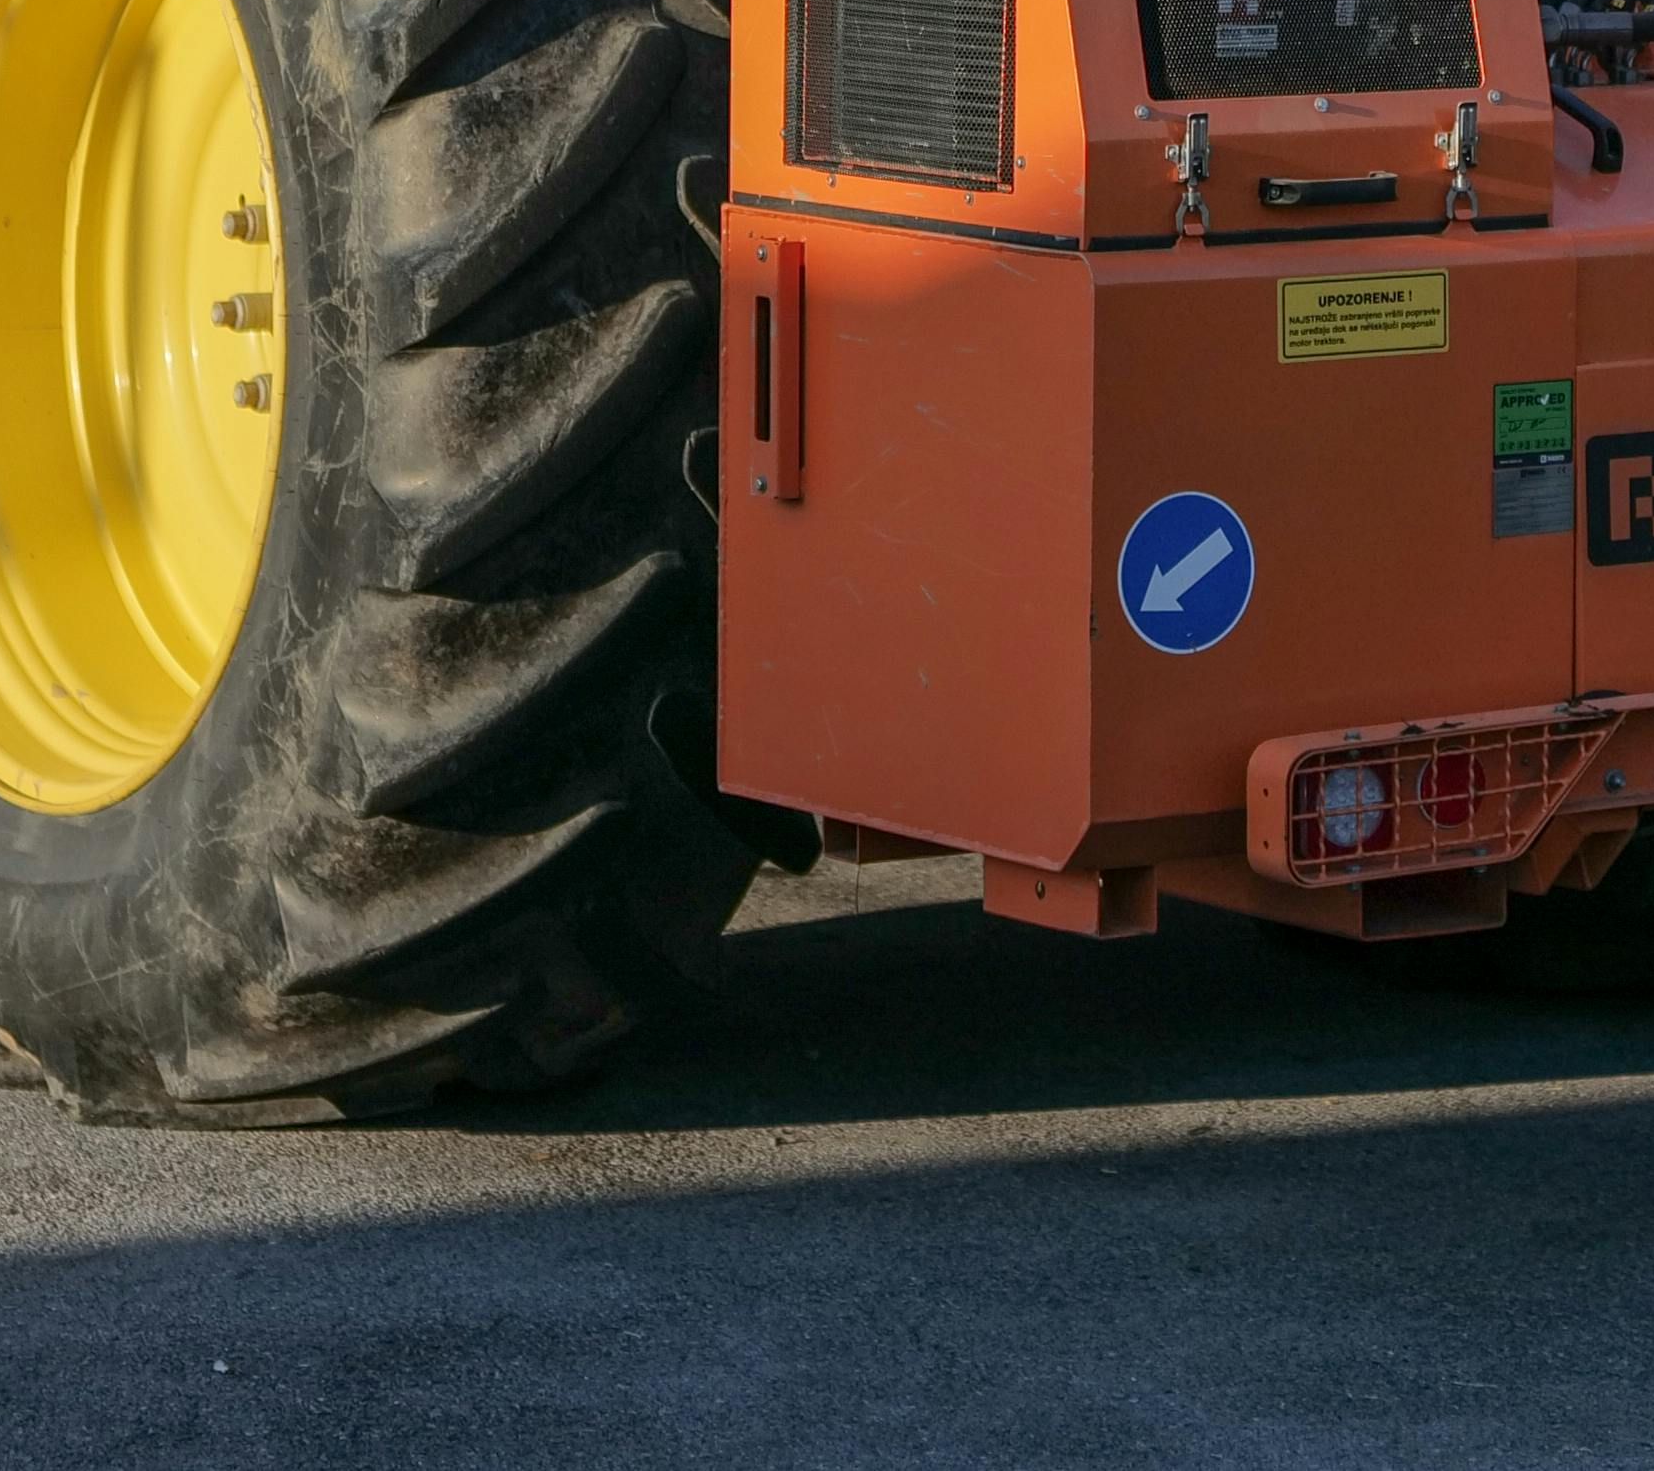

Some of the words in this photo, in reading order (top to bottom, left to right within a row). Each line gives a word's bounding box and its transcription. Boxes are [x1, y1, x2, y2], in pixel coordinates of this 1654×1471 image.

[1318, 290, 1405, 308] UPOZORENJE
[1408, 289, 1413, 302] !
[1289, 311, 1337, 324] NAJSTROŽE
[1339, 310, 1383, 321] zabranjeno
[1406, 307, 1441, 319] popravke
[1289, 328, 1299, 337] na
[1332, 324, 1346, 333] dok
[1401, 318, 1436, 330] pogonski
